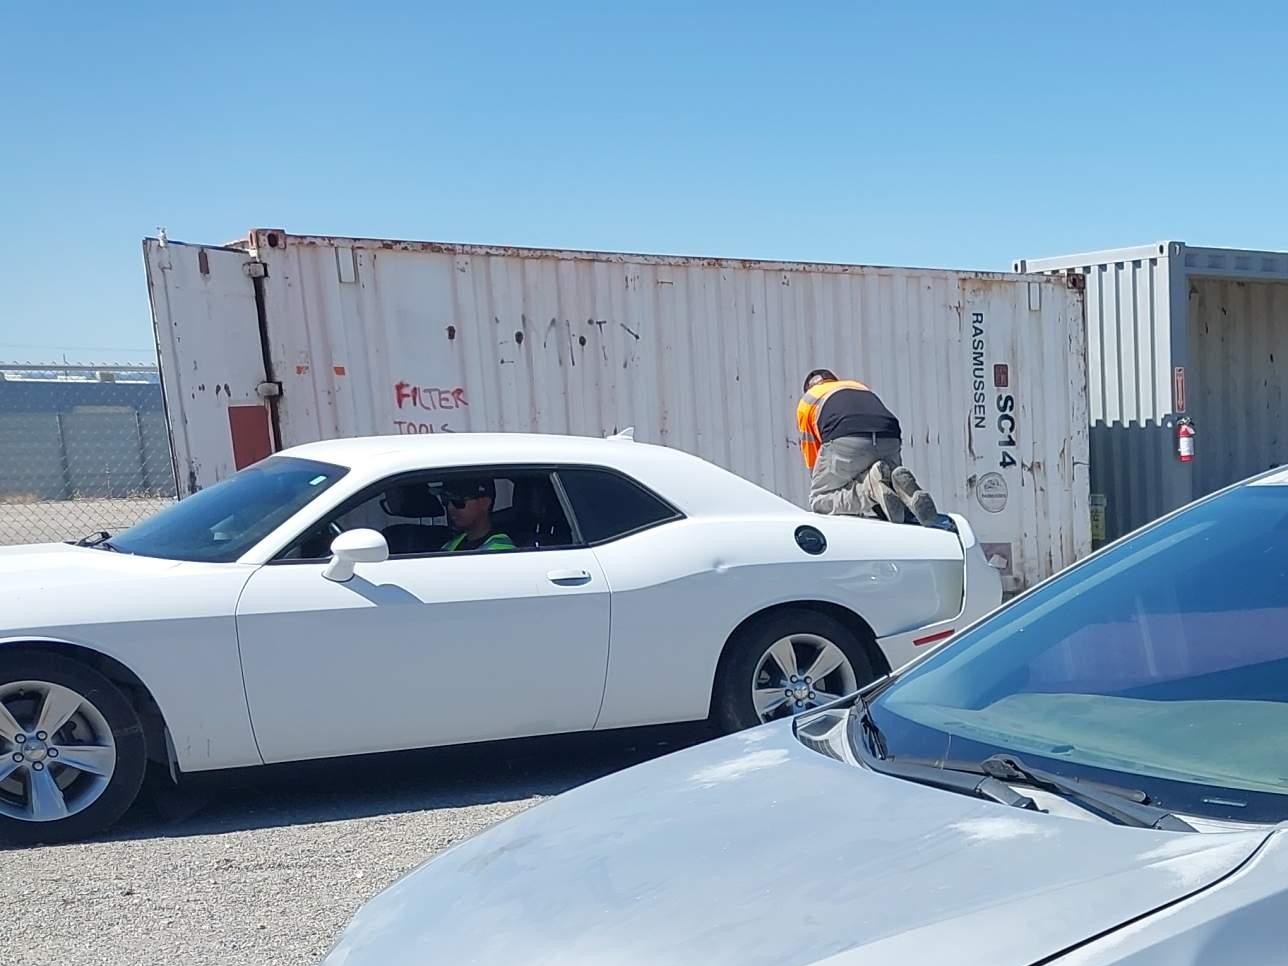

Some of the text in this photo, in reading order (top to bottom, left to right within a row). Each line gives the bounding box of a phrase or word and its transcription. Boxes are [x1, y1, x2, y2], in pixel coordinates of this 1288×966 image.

[395, 381, 469, 411] FILTER
[971, 312, 986, 429] RASMUSSEN
[996, 394, 1017, 469] SC14
